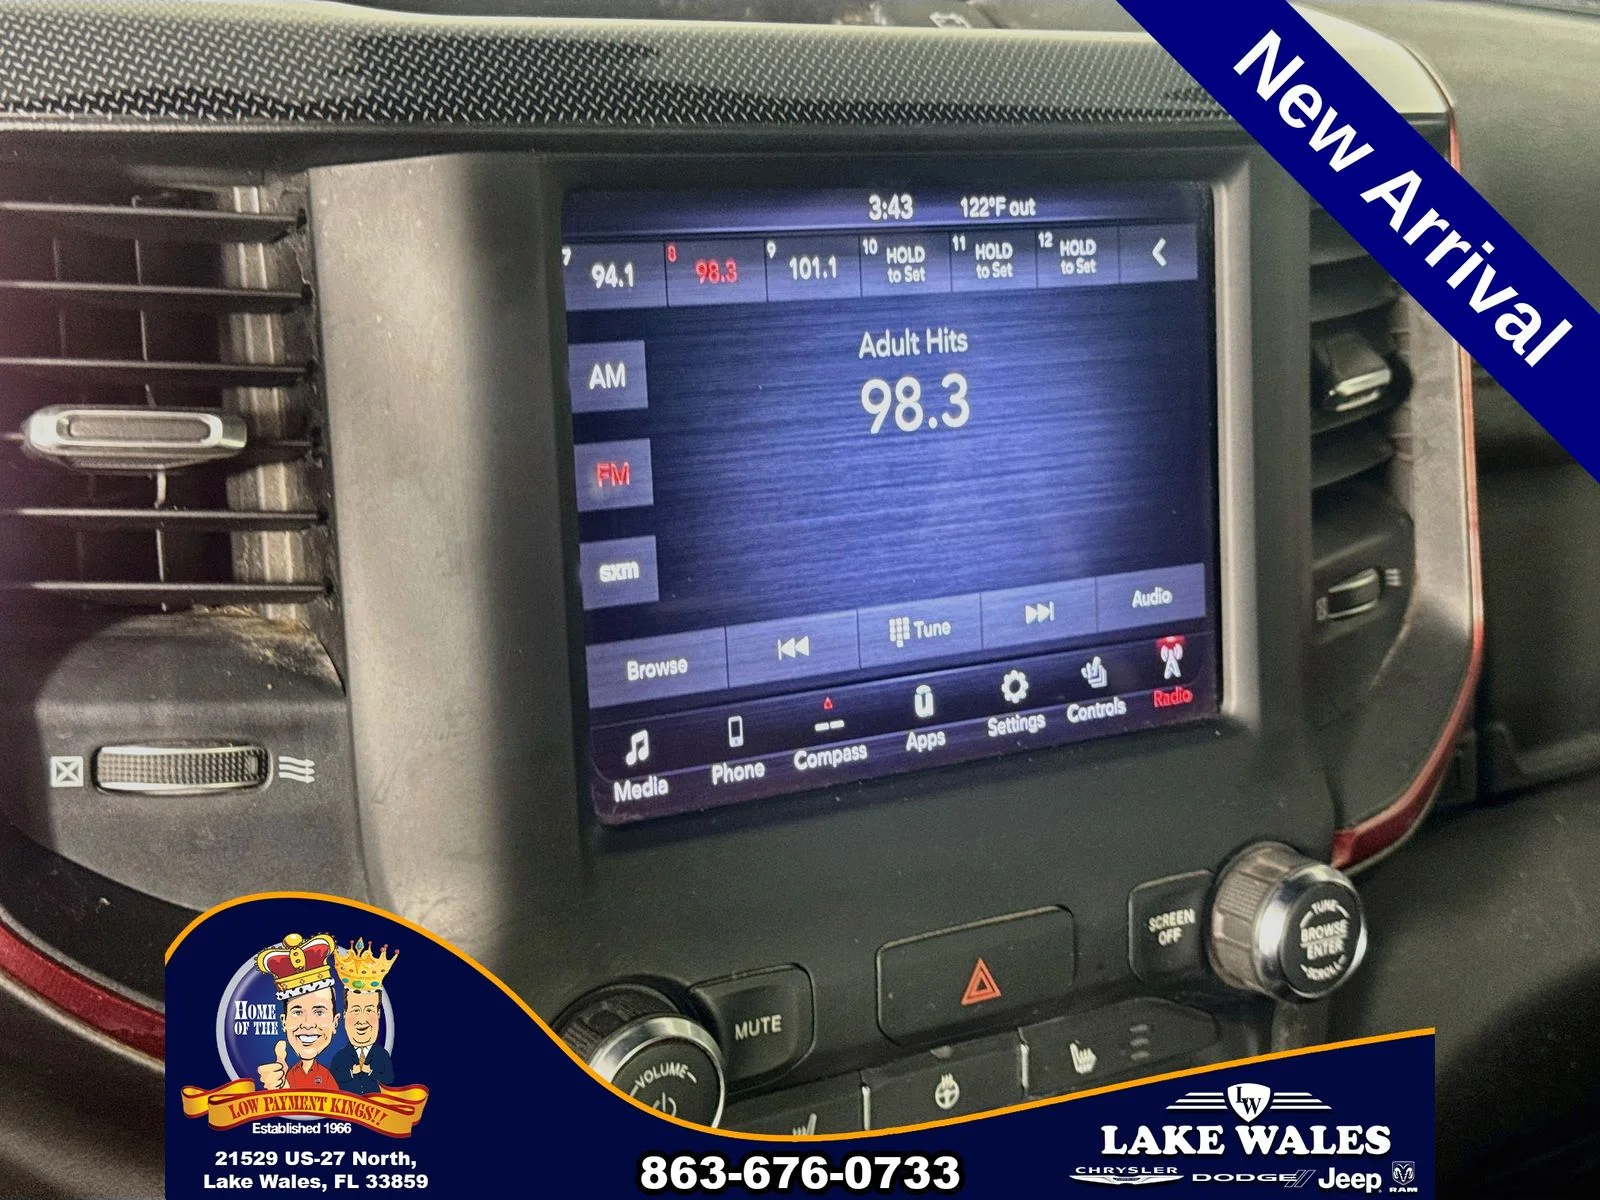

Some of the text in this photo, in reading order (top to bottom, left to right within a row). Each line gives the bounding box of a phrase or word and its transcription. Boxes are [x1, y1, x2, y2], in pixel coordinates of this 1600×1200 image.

[868, 194, 913, 220] 3:43
[1009, 198, 1036, 217] out
[766, 241, 776, 258] 9
[862, 238, 878, 256] 10
[952, 235, 966, 252] 11
[975, 242, 1013, 260] HOLD
[1038, 232, 1053, 248] 12
[1060, 239, 1097, 257] HOLD
[562, 247, 571, 266] 7
[886, 246, 925, 264] HOLD
[1061, 258, 1097, 275] to Set
[591, 262, 634, 288] 94.1
[695, 259, 738, 284] 98.3
[788, 255, 837, 280] 101.1
[887, 265, 926, 283] to Set
[976, 262, 1013, 279] to Set
[858, 326, 968, 359] Adult Hits
[589, 361, 626, 389] AM
[861, 373, 970, 434] 98.3
[596, 461, 631, 487] FM
[1132, 586, 1173, 609] Audio
[914, 619, 951, 639] Tune
[627, 658, 688, 681] Browse
[1153, 685, 1193, 708] Radio
[1067, 697, 1127, 723] Controls
[987, 713, 1046, 738] Settings
[906, 730, 946, 752] Apps
[794, 745, 867, 771] Compass
[711, 762, 765, 785] Phone
[613, 775, 669, 803] Media
[1311, 899, 1338, 914] TUNE
[1148, 908, 1195, 932] SCREEN
[1301, 919, 1348, 943] BROWSE
[1158, 927, 1182, 947] OFF
[1306, 939, 1344, 960] ENTER
[734, 1014, 782, 1040] MUTE
[634, 1062, 688, 1089] VOLUME
